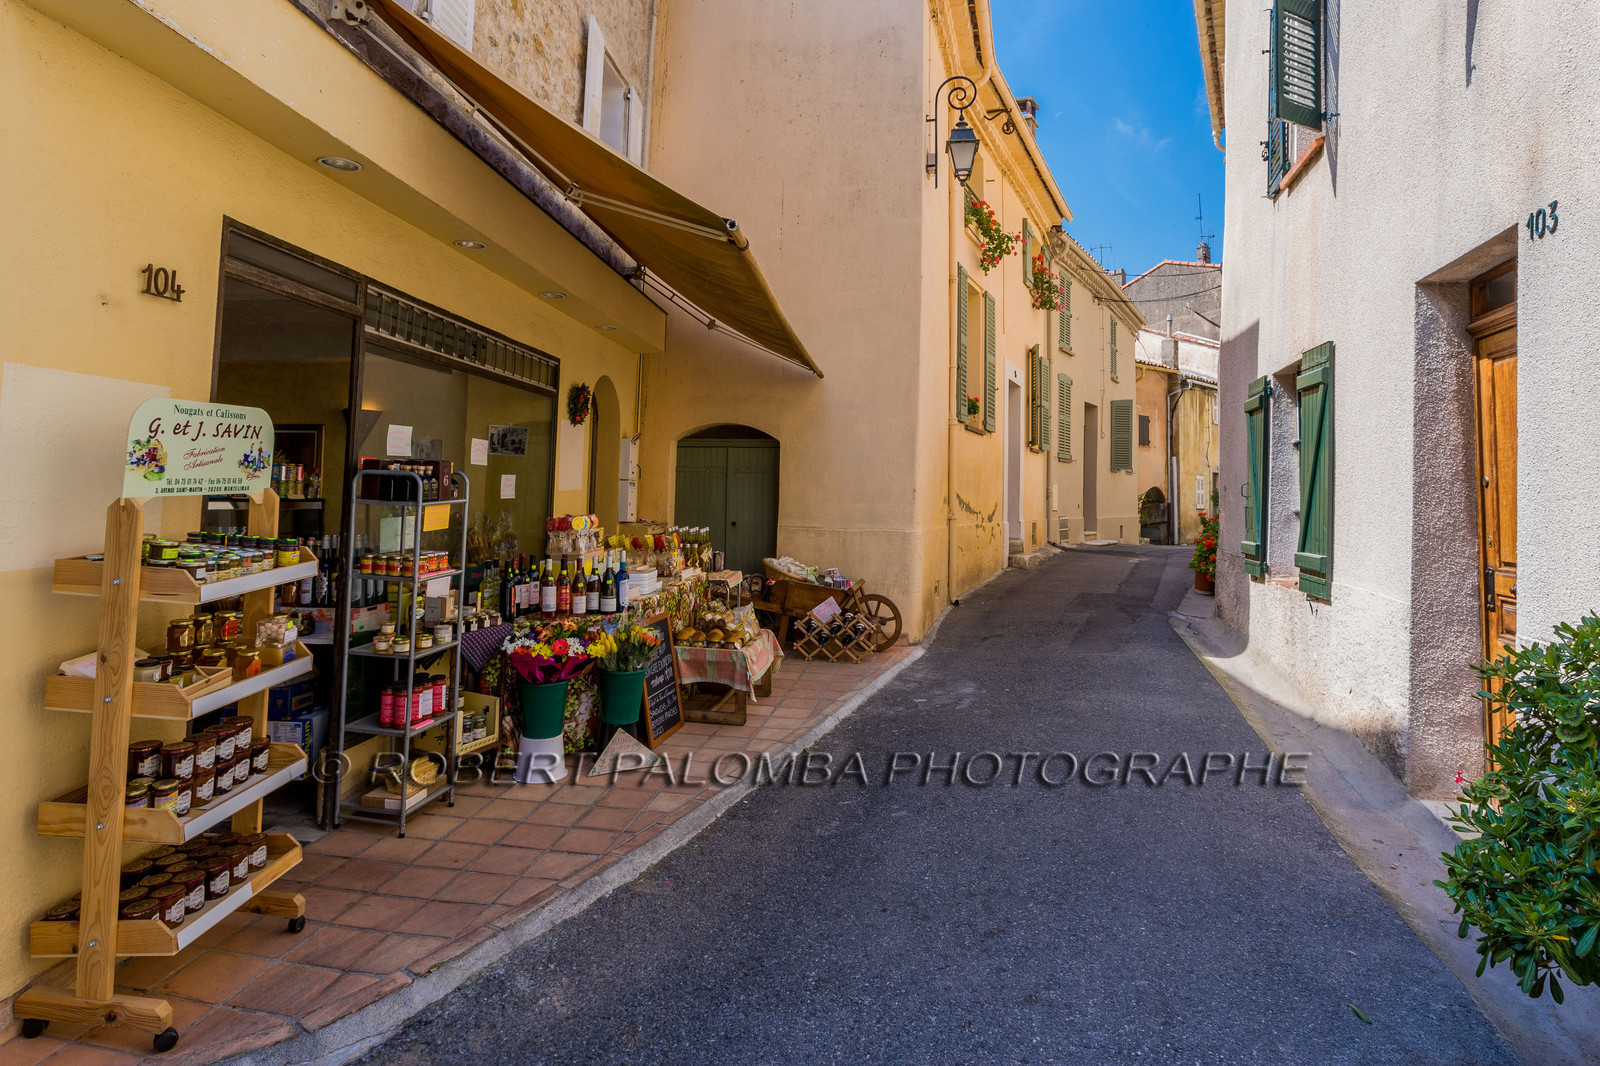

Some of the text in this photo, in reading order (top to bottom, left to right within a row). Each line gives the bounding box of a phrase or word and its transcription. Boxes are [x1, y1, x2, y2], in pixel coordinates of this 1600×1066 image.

[1526, 200, 1558, 241] 103
[142, 264, 186, 302] 104
[173, 404, 204, 417] Nougats
[215, 408, 247, 420] Calissons
[148, 417, 263, 442] G. et J. SAVIN
[183, 446, 226, 460] Fabrication
[184, 454, 224, 470] Artisanale
[443, 474, 449, 486] 6
